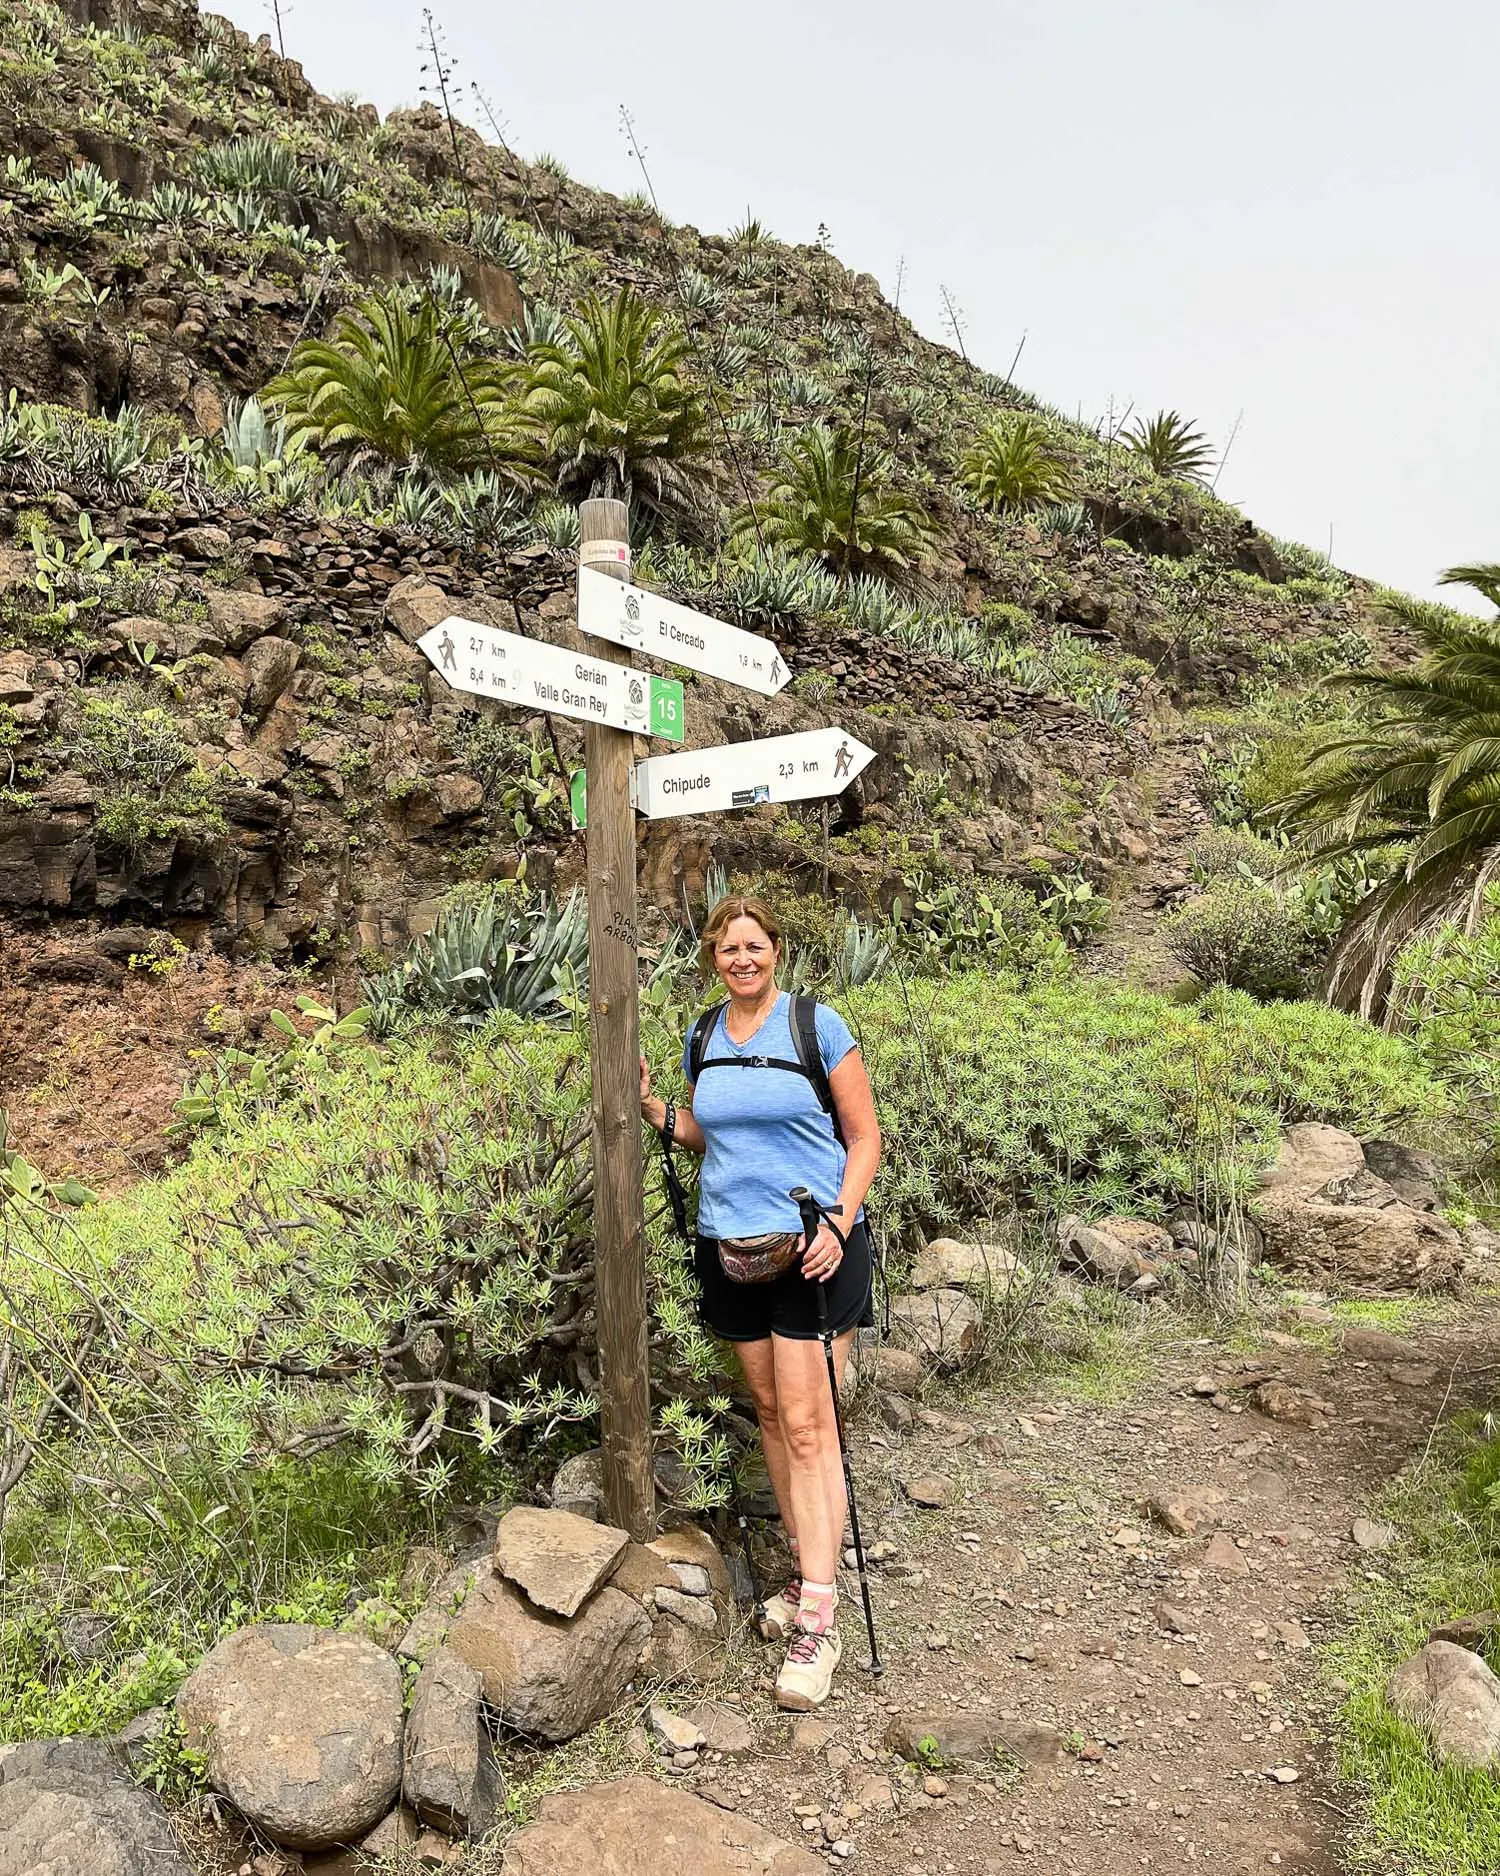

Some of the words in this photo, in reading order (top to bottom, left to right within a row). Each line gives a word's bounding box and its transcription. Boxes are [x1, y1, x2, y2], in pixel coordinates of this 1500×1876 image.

[659, 621, 668, 637] El
[670, 625, 705, 650] Cercado
[470, 637, 484, 655] 2,7
[491, 643, 506, 659] km
[752, 658, 763, 671] km
[470, 667, 484, 686] 8,4
[491, 672, 506, 689] km
[534, 681, 559, 702] Valle
[562, 688, 586, 708] Gran
[589, 695, 608, 718] Rey
[657, 697, 677, 721] 15
[779, 762, 794, 780] 2,3
[802, 760, 819, 773] km
[662, 773, 711, 796] Chipude
